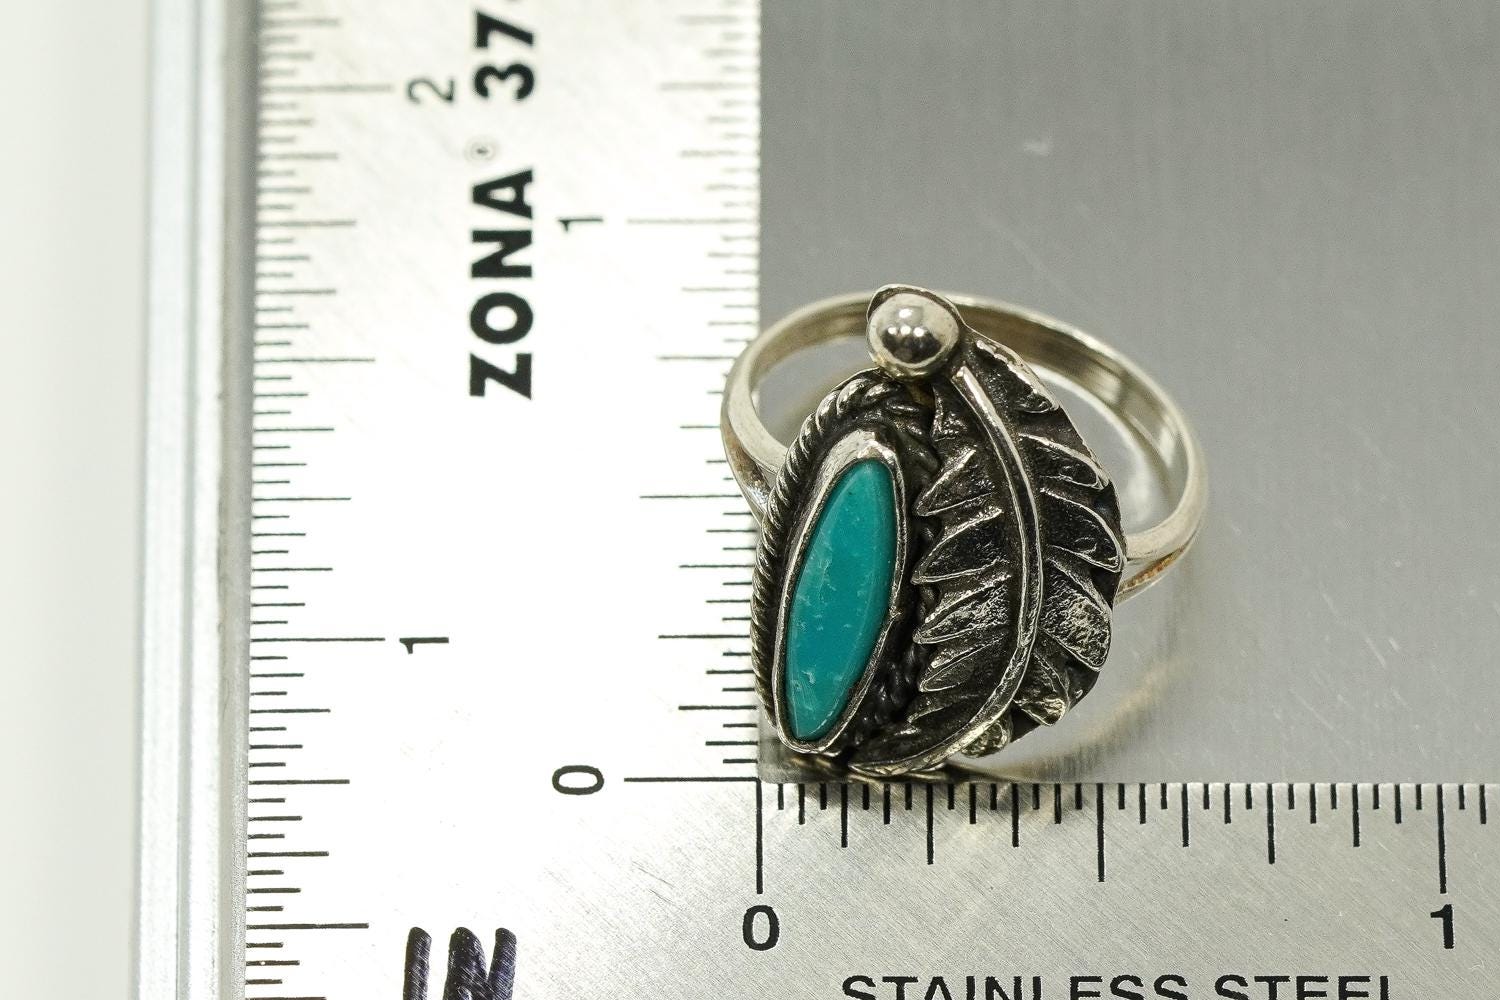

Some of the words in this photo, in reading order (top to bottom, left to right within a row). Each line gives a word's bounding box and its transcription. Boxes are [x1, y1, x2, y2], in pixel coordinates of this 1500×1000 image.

[407, 76, 455, 105] 2
[557, 217, 604, 232] 1
[469, 168, 535, 399] ZONA
[400, 638, 448, 653] 1
[552, 766, 604, 795] 0
[743, 905, 779, 951] 0
[1430, 904, 1454, 949] 1
